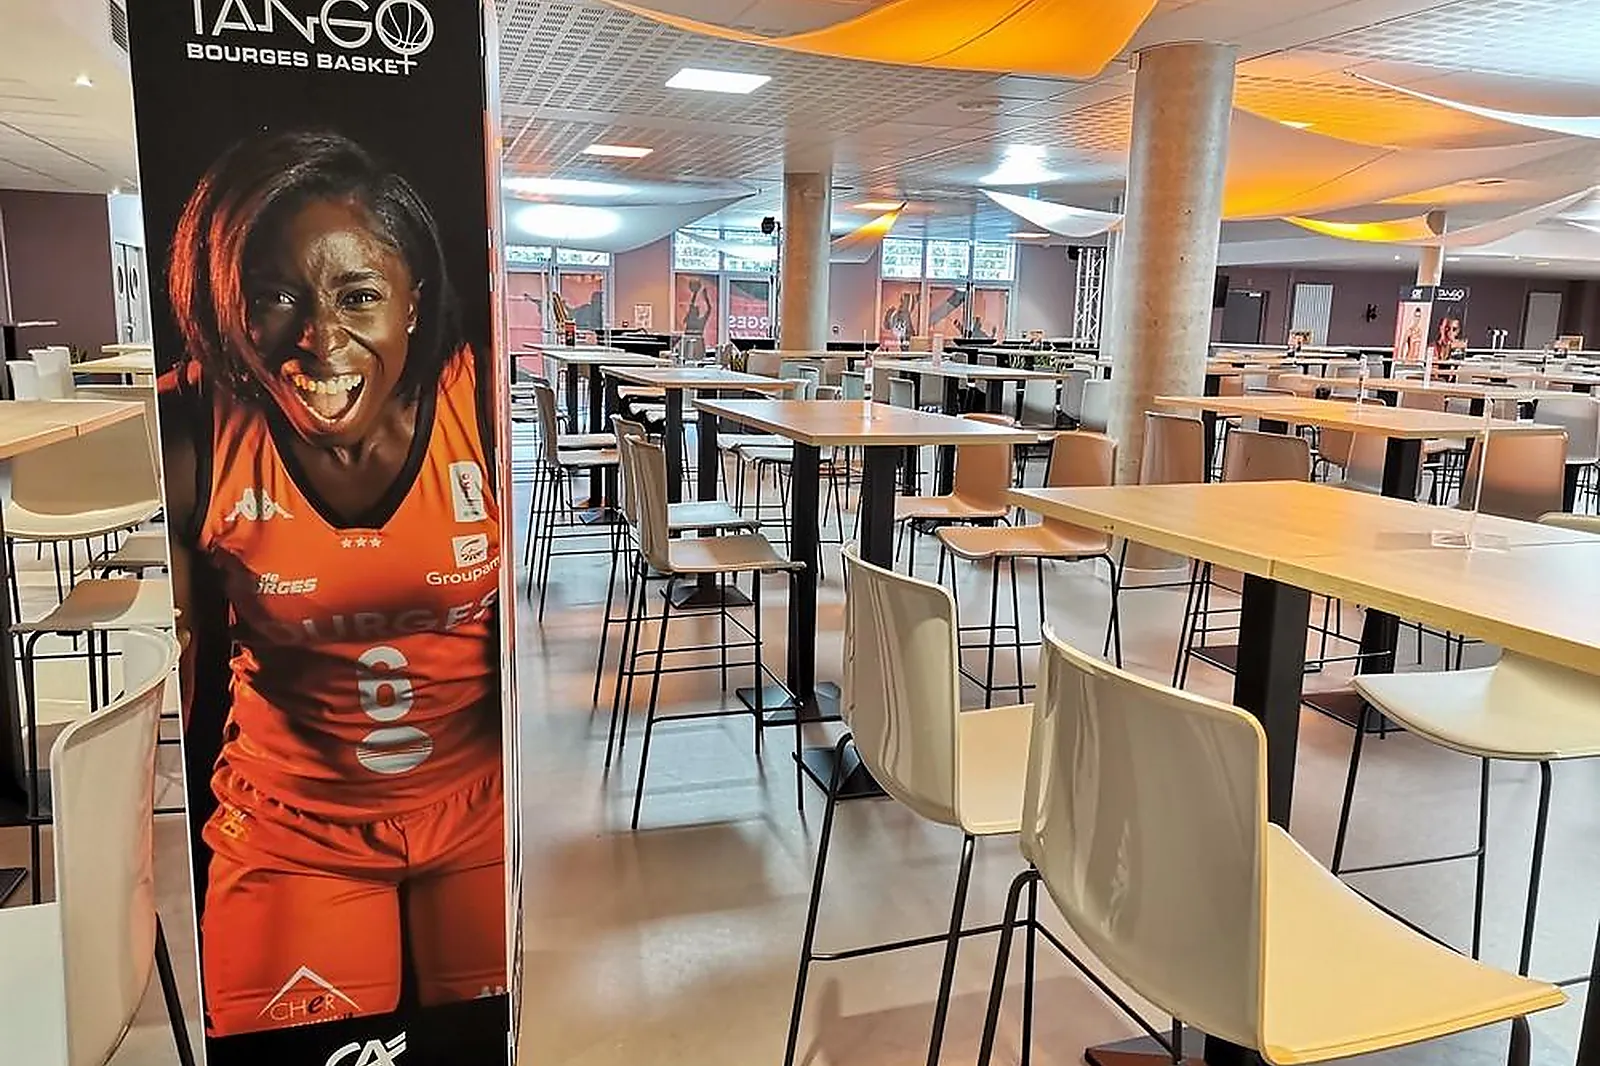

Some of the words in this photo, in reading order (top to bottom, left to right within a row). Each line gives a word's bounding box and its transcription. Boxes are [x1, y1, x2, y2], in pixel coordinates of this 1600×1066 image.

[186, 43, 309, 68] BOURGES
[316, 53, 418, 75] BASKET
[257, 578, 318, 595] RGES
[256, 588, 499, 645] OURGES
[356, 645, 414, 722] 6
